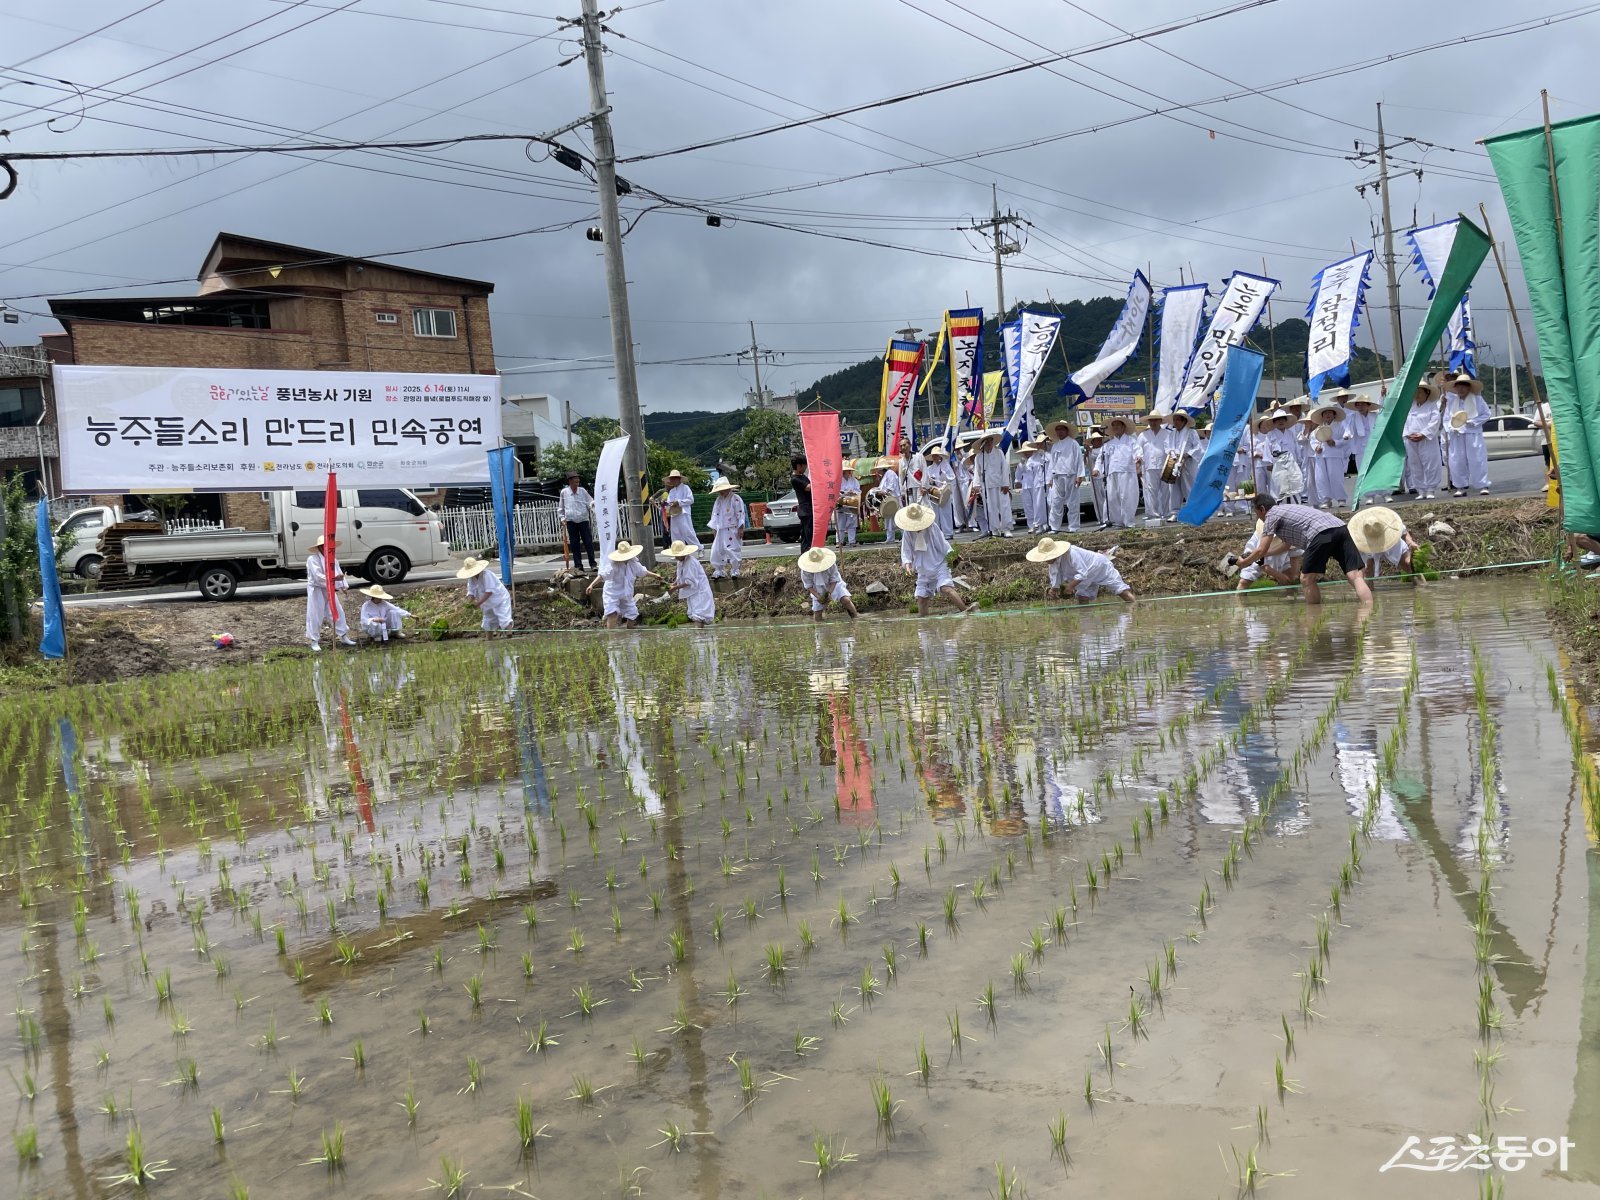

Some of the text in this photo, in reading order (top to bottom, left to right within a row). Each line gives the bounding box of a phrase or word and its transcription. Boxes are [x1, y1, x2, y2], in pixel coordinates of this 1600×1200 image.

[1223, 283, 1260, 322] 능주
[1313, 293, 1348, 354] 잠정리
[1192, 328, 1237, 393] 만인리
[276, 387, 338, 402] 풍년농사
[343, 389, 372, 402] 기원
[86, 416, 483, 447] 능주들소리 만드리 민속공연
[148, 463, 164, 472] 주관
[171, 463, 234, 472] 능주들소리보존회
[240, 463, 256, 472] 후원
[276, 462, 302, 471] 전라남도
